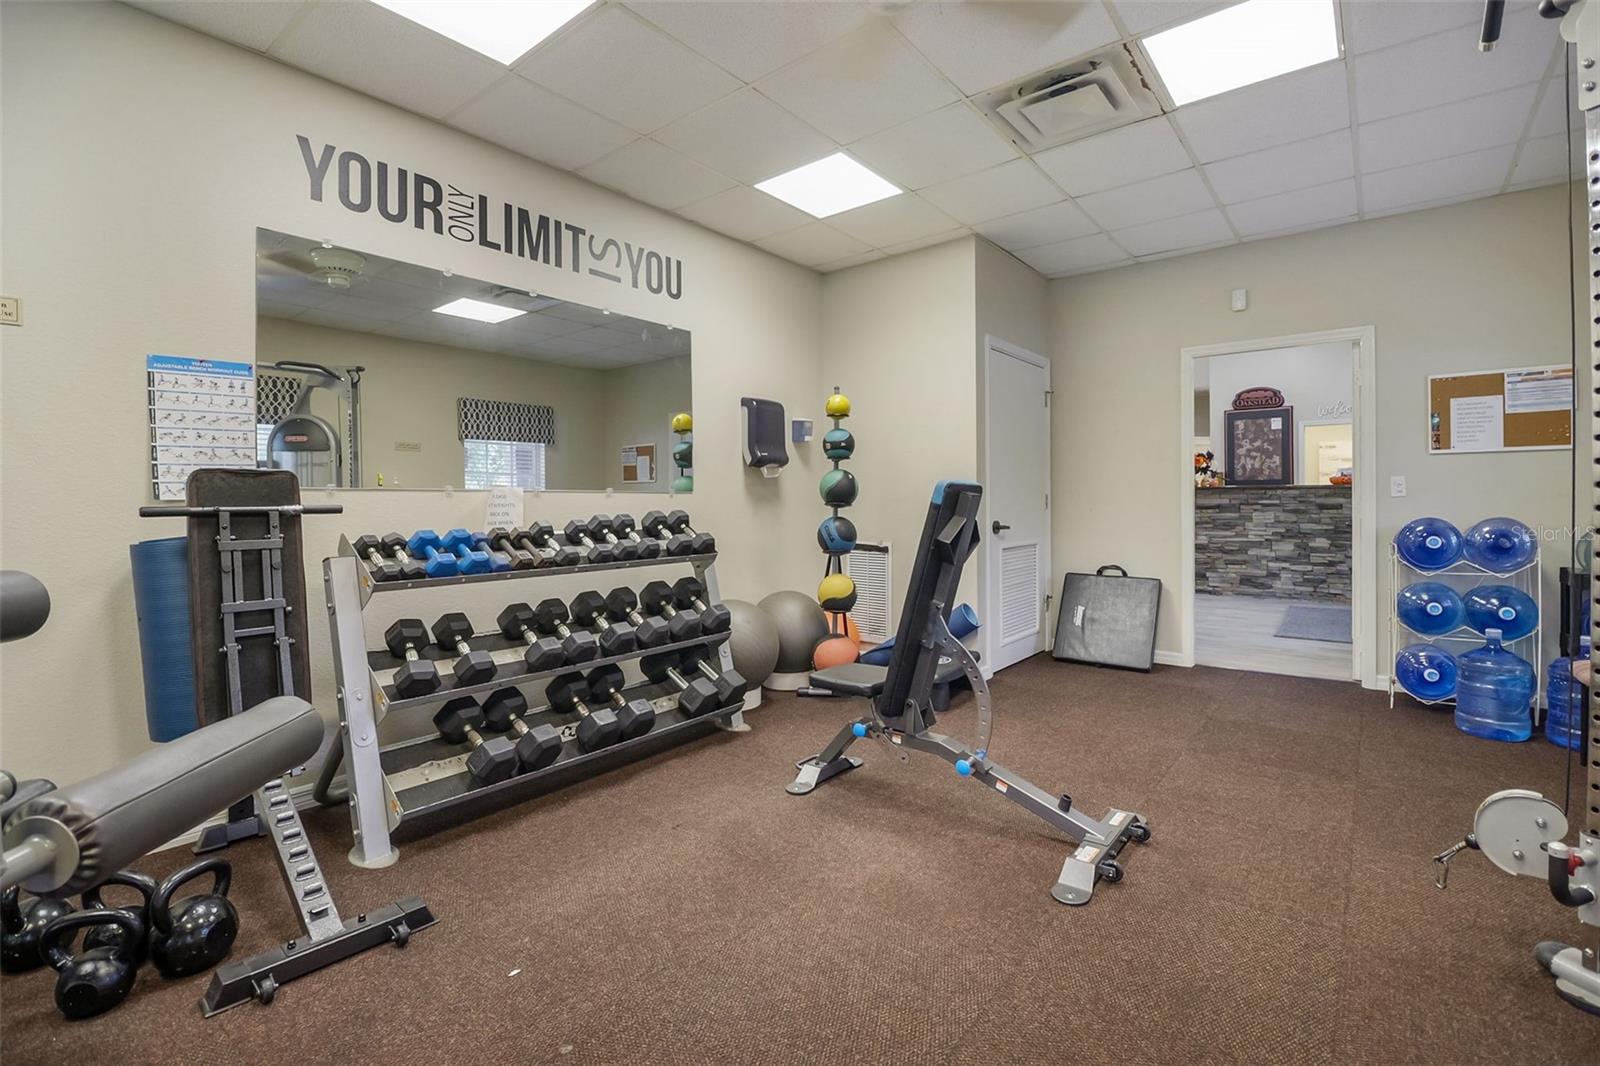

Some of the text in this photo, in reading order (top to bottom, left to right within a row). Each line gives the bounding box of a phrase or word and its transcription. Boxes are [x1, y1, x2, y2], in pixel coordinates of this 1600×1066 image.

[296, 134, 682, 300] YOUR ONLY LIMIT IS YOU
